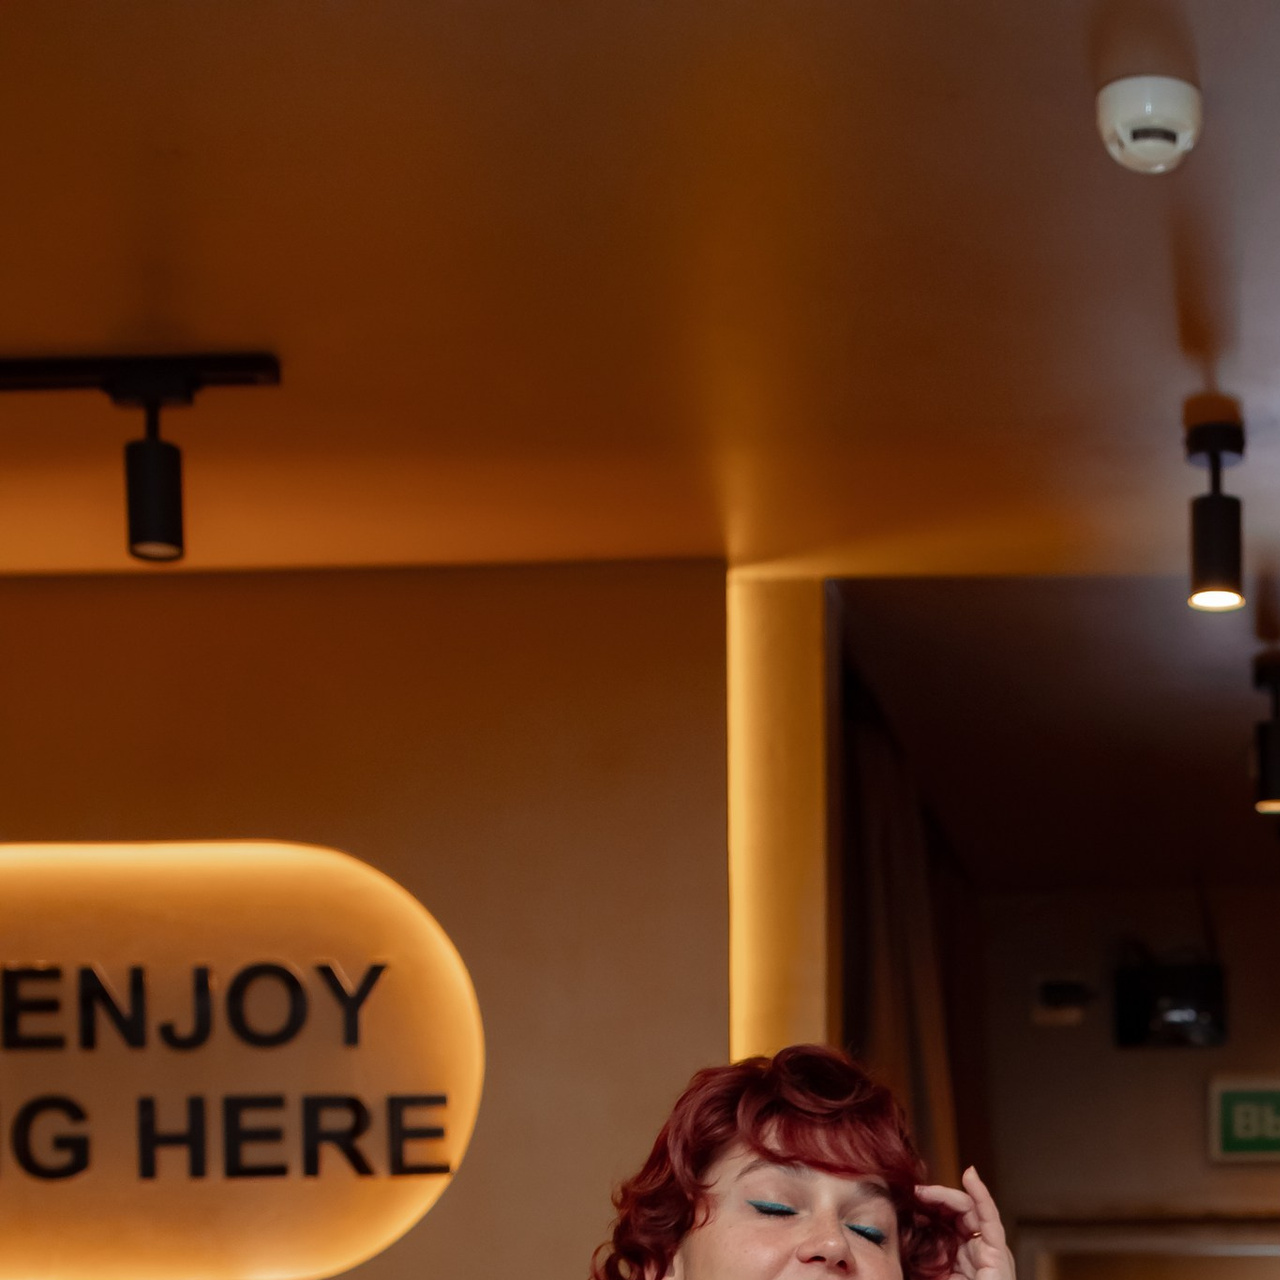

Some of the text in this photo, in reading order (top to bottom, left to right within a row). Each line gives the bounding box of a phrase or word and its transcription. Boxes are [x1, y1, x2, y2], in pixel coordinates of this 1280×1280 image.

[1, 962, 389, 1050] ENJOY
[0, 1094, 452, 1180] G HERE
